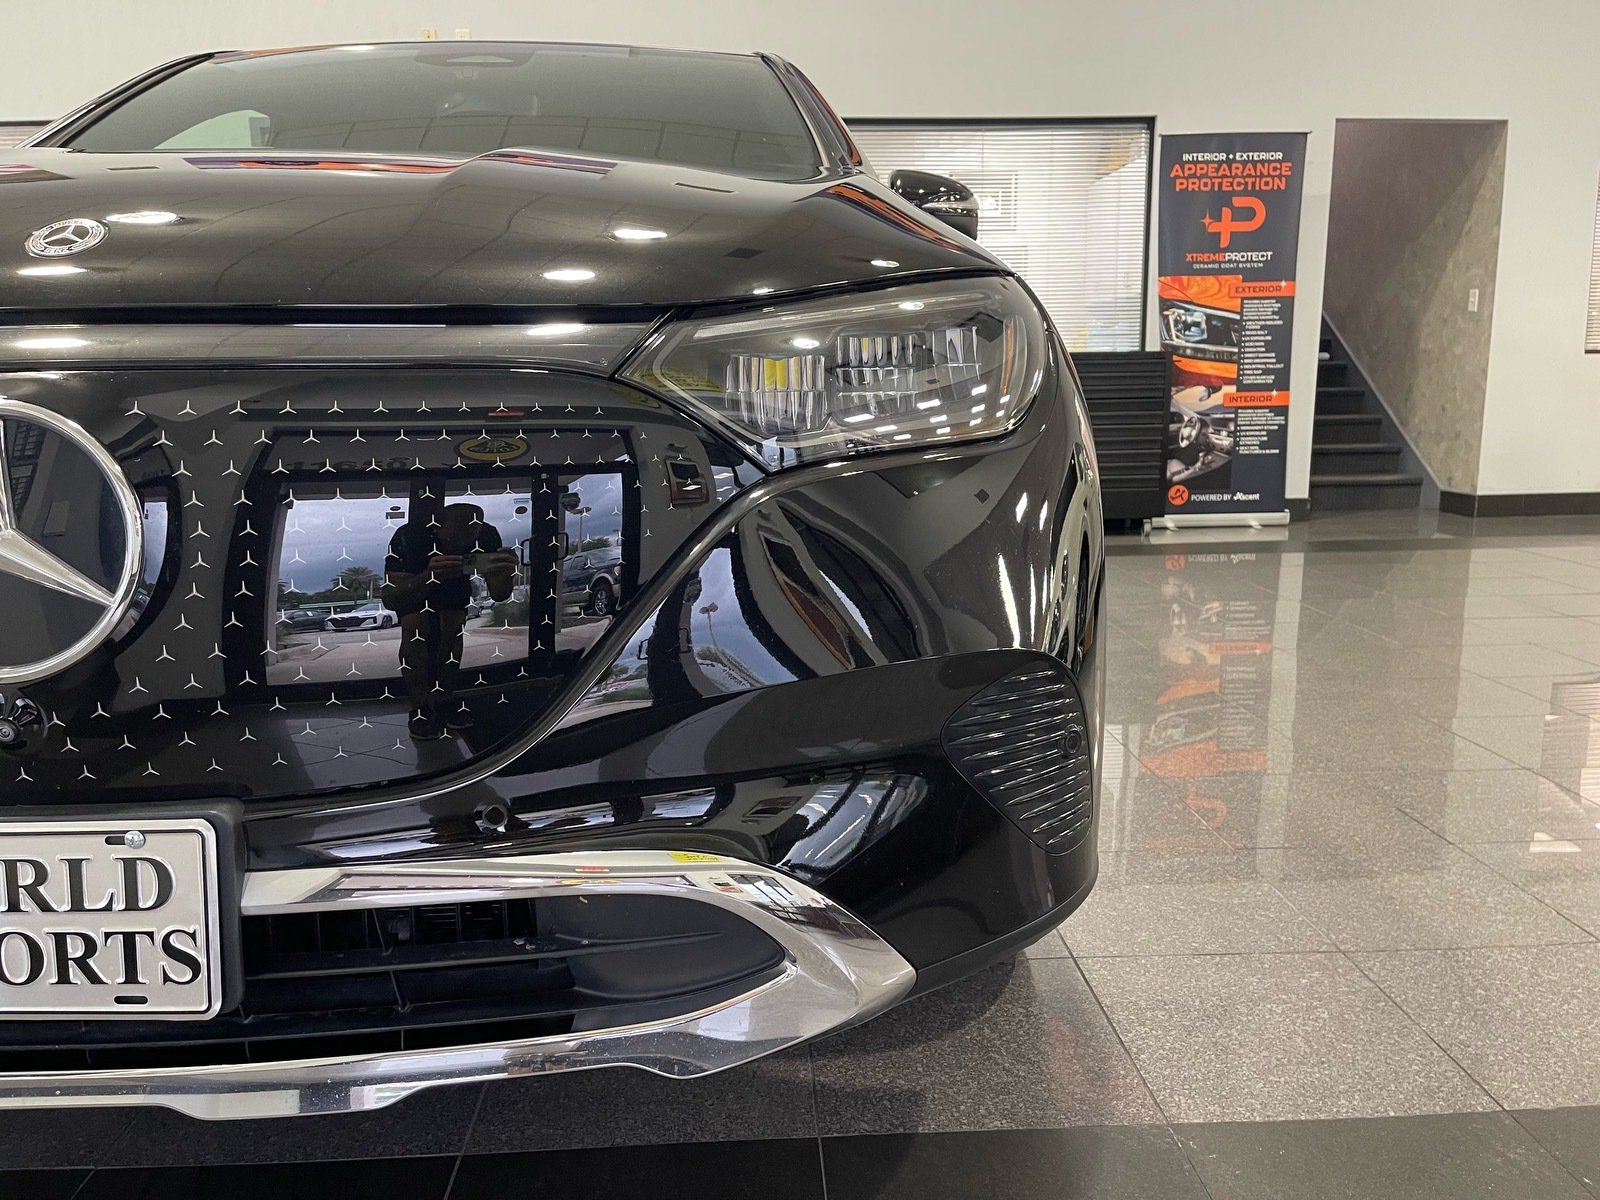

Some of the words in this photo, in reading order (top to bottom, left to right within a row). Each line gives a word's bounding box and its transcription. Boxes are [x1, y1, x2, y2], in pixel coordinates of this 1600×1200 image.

[1182, 152, 1227, 162] INTERIOR
[1235, 151, 1283, 161] EXTERIOR
[1170, 162, 1292, 178] APPEARANCE
[1175, 177, 1286, 192] PROTECTION
[1235, 285, 1282, 294] EXTERIOR
[1228, 395, 1273, 403] INTERIOR
[1191, 493, 1222, 501] POWERED
[1223, 493, 1232, 501] BY
[1233, 491, 1260, 501] Ascent
[0, 928, 202, 986] ORTS
